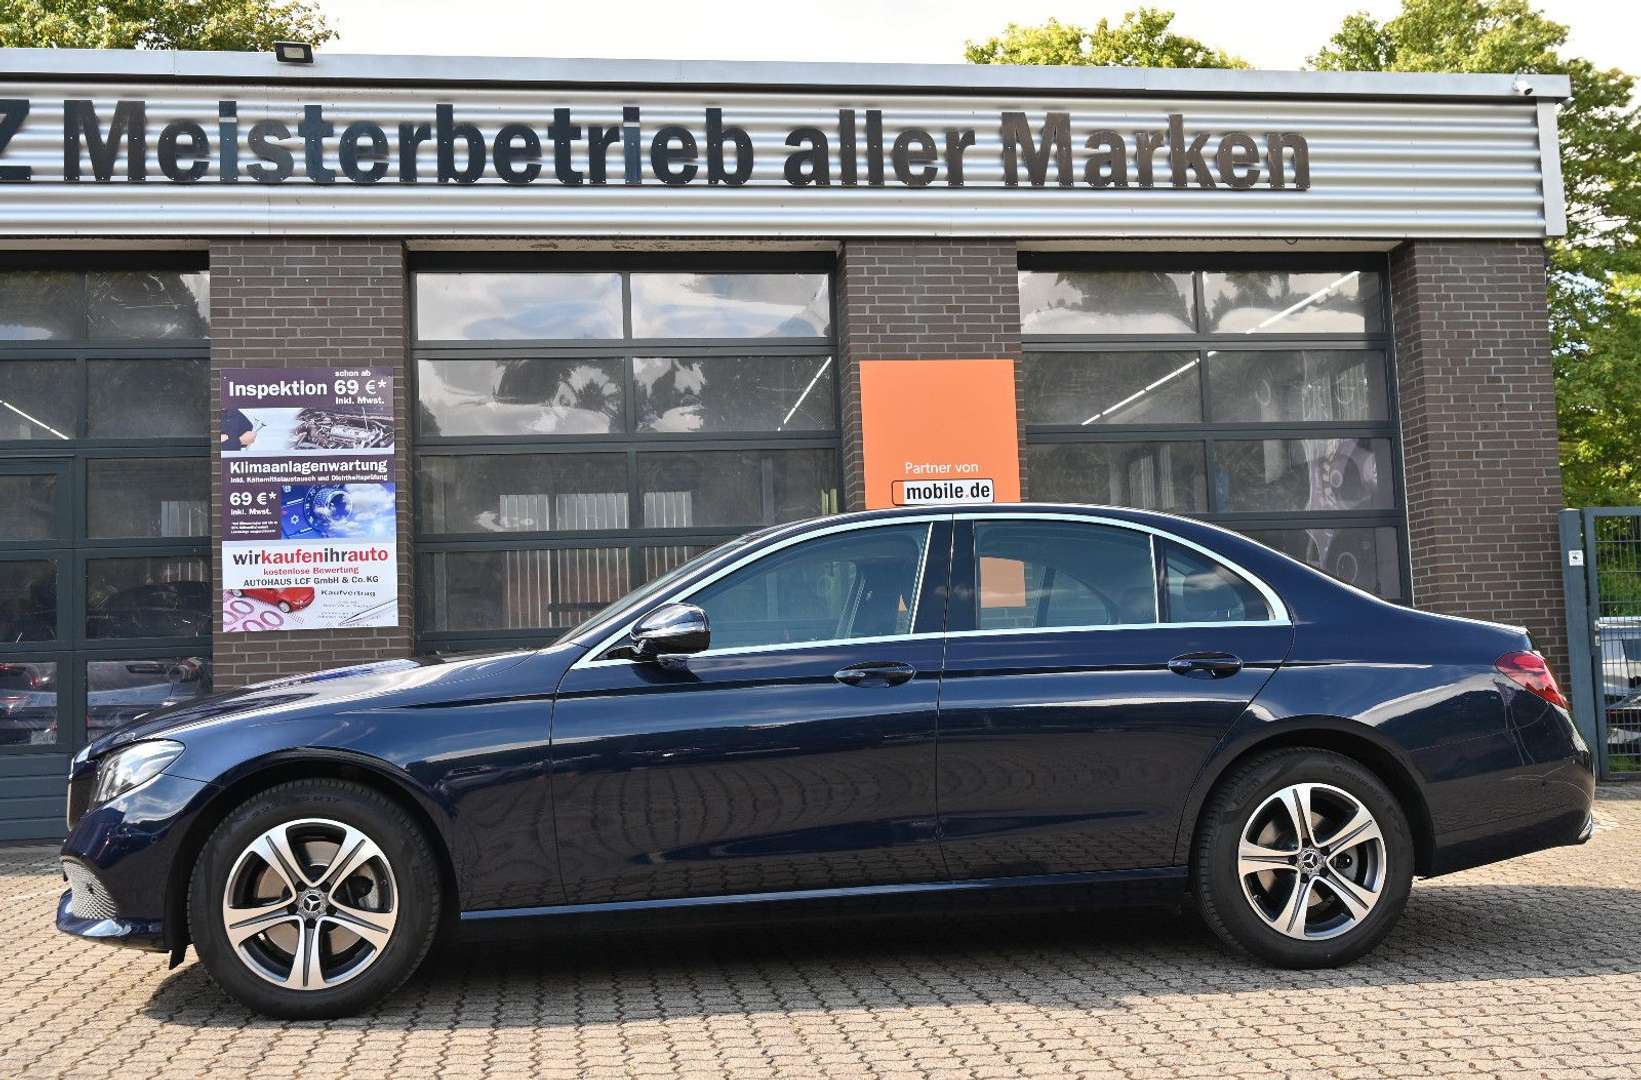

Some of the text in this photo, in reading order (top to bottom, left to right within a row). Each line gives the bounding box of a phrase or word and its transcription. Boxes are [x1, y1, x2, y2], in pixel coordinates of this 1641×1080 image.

[63, 100, 754, 187] Meisterbetrieb
[784, 108, 976, 188] aller
[1000, 111, 1310, 192] Marken
[229, 380, 328, 399] Inspektion
[334, 379, 359, 395] 69
[357, 396, 385, 405] Mwst.
[230, 460, 388, 475] Klimaanlagenwartung
[905, 462, 979, 474] Partner von
[906, 482, 990, 500] mobile.de
[229, 492, 253, 506] 69
[233, 547, 389, 565] wirkaufenihrauto
[263, 566, 359, 576] kostenlose Bewertung
[243, 578, 292, 587] AUTOHAUS
[294, 577, 312, 586] LCF
[313, 577, 340, 585] GmbH
